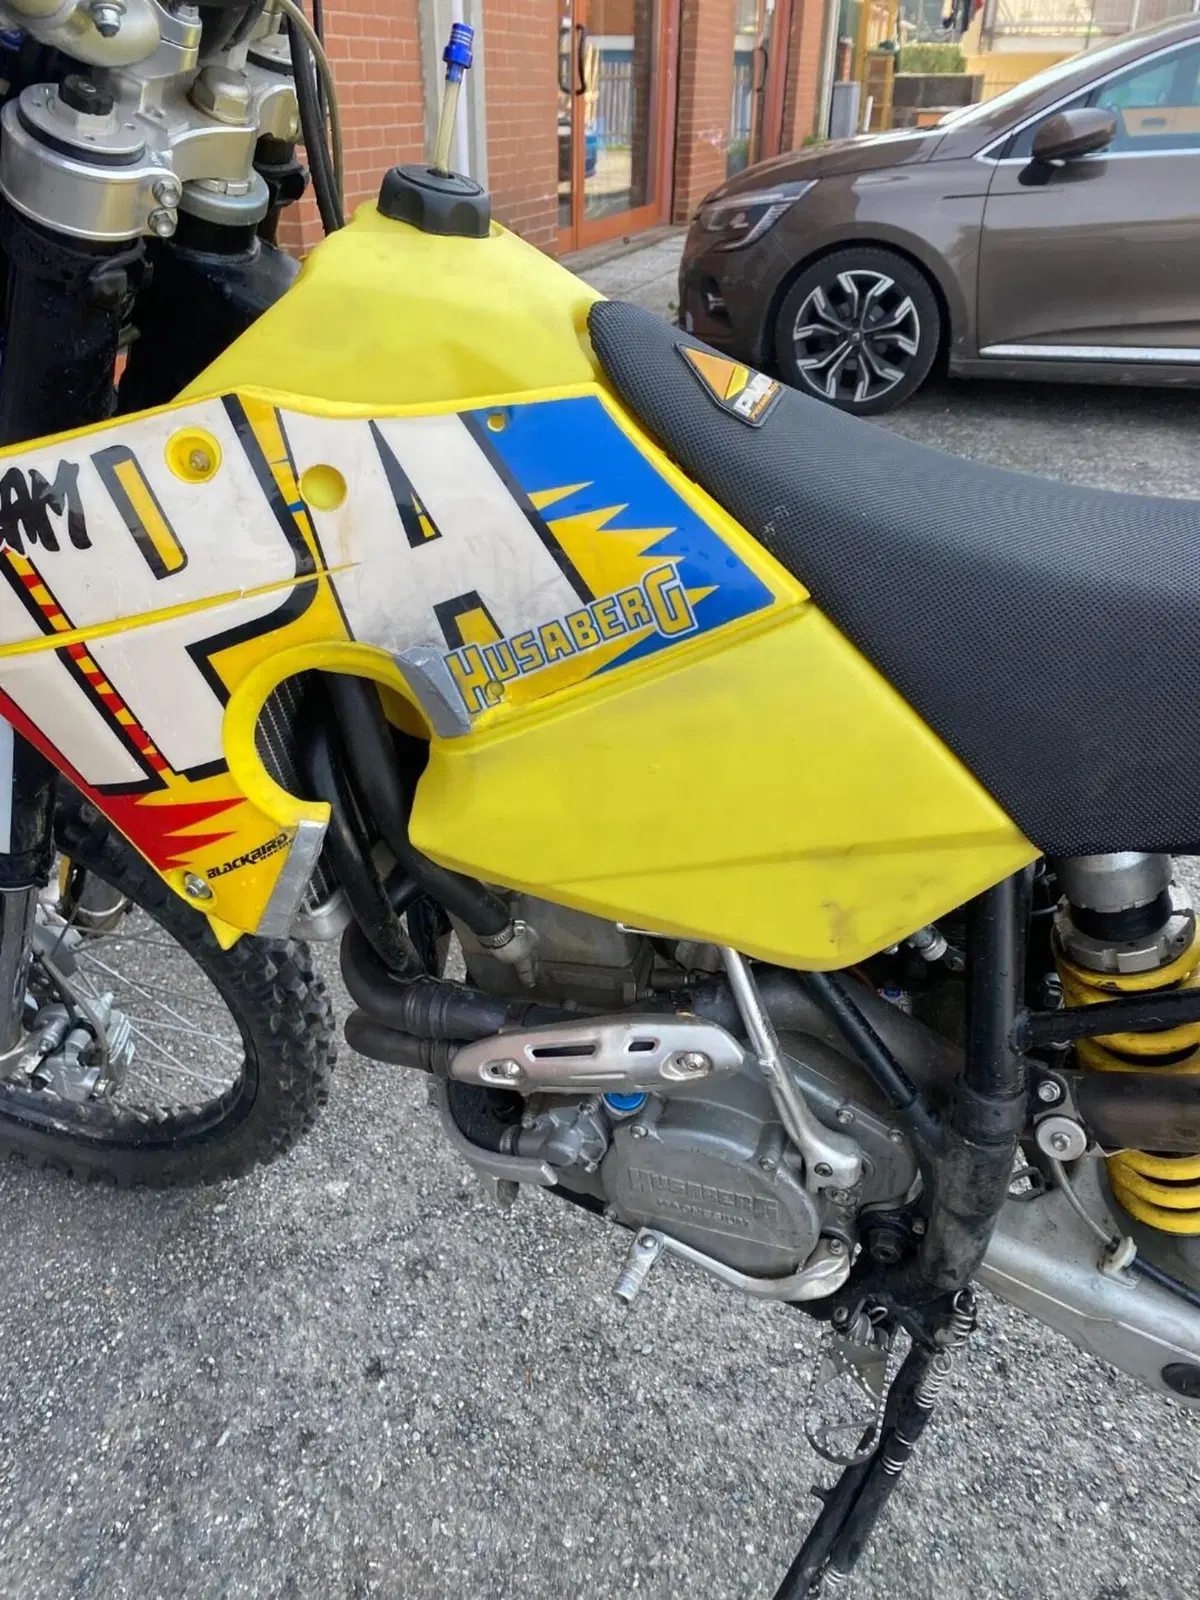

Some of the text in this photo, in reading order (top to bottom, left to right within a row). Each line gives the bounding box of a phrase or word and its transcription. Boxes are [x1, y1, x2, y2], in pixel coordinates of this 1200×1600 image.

[0, 459, 93, 554] AM
[443, 561, 697, 715] HUSABERG
[206, 832, 288, 879] BLACKBIRD
[627, 1167, 780, 1224] HUSABERG
